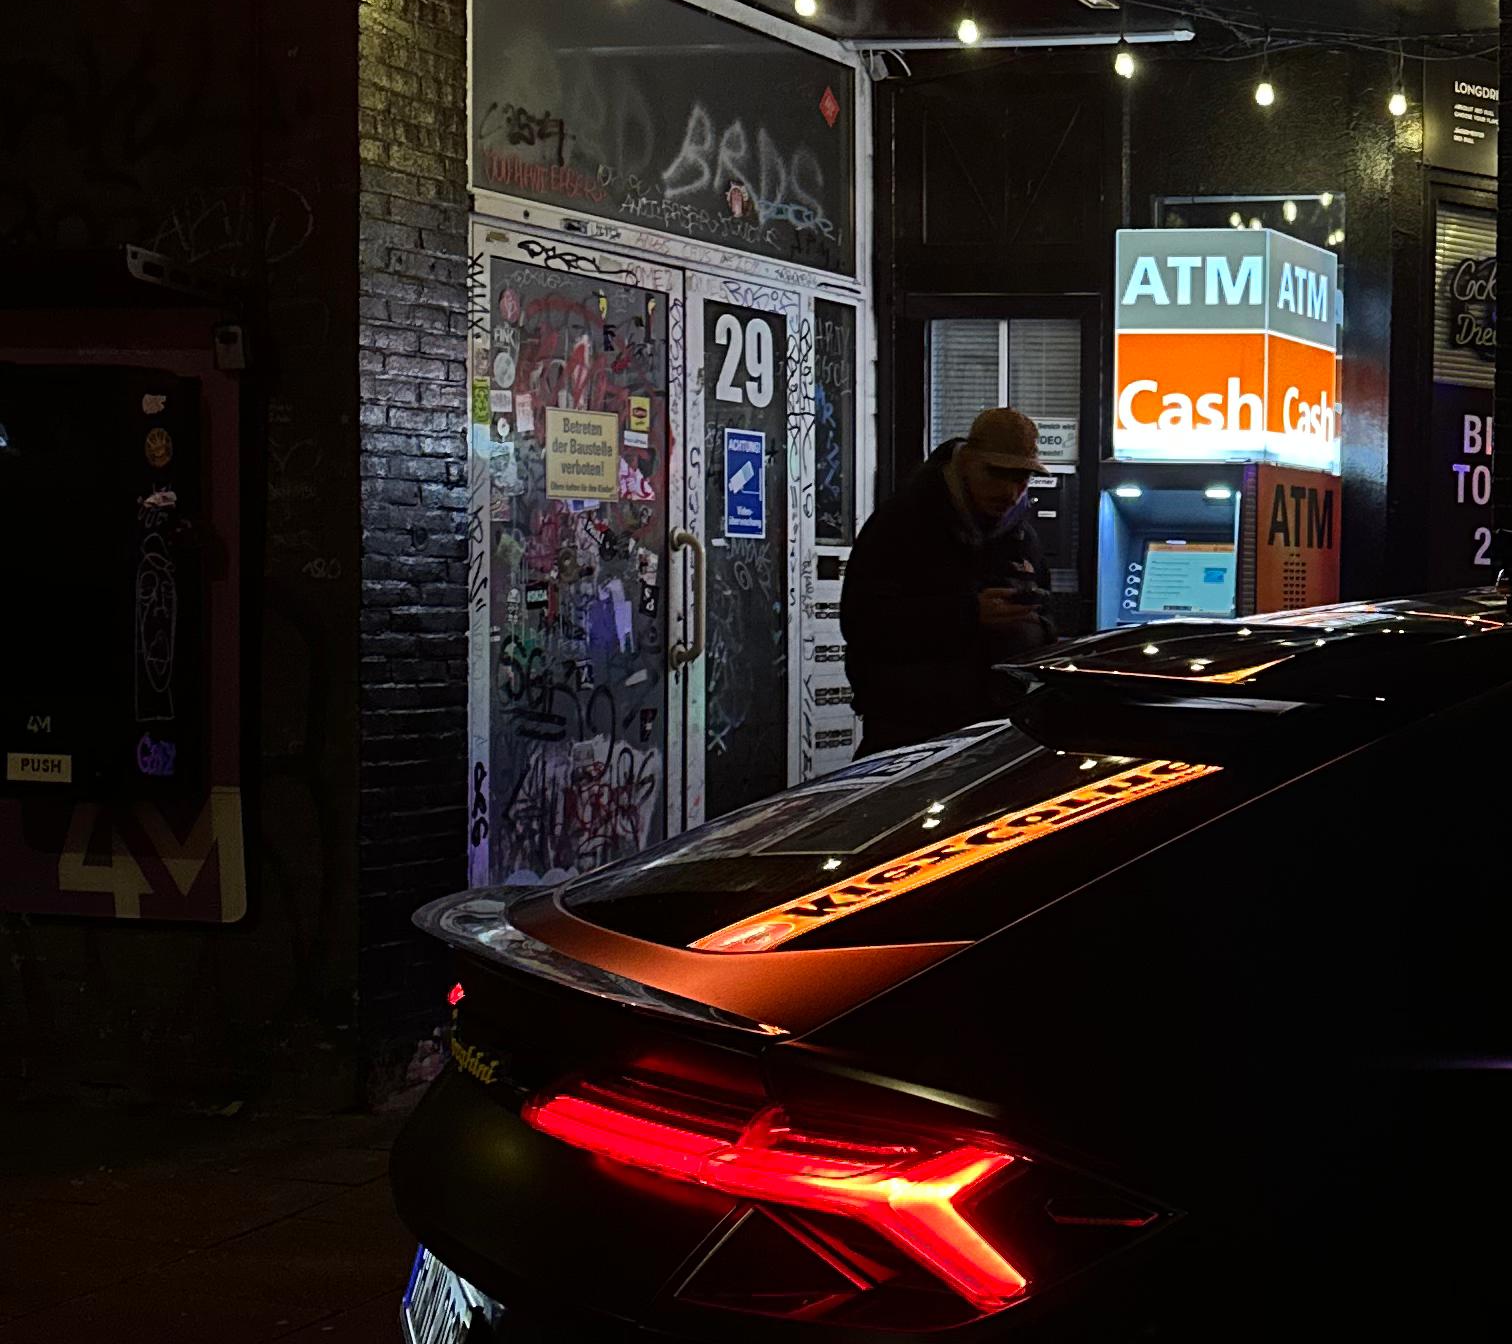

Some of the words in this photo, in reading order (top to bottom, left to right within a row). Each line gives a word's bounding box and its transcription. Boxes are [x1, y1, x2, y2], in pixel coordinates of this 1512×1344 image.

[1121, 256, 1264, 306] ATM
[1277, 262, 1329, 322] ATM
[715, 313, 775, 408] 29
[562, 417, 603, 436] Betreten
[1118, 377, 1264, 431] Cash
[1284, 387, 1334, 443] Cash
[1038, 435, 1063, 445] DEO
[1267, 484, 1333, 550] ATM
[1474, 526, 1492, 566] 2
[21, 758, 62, 774] PUSH
